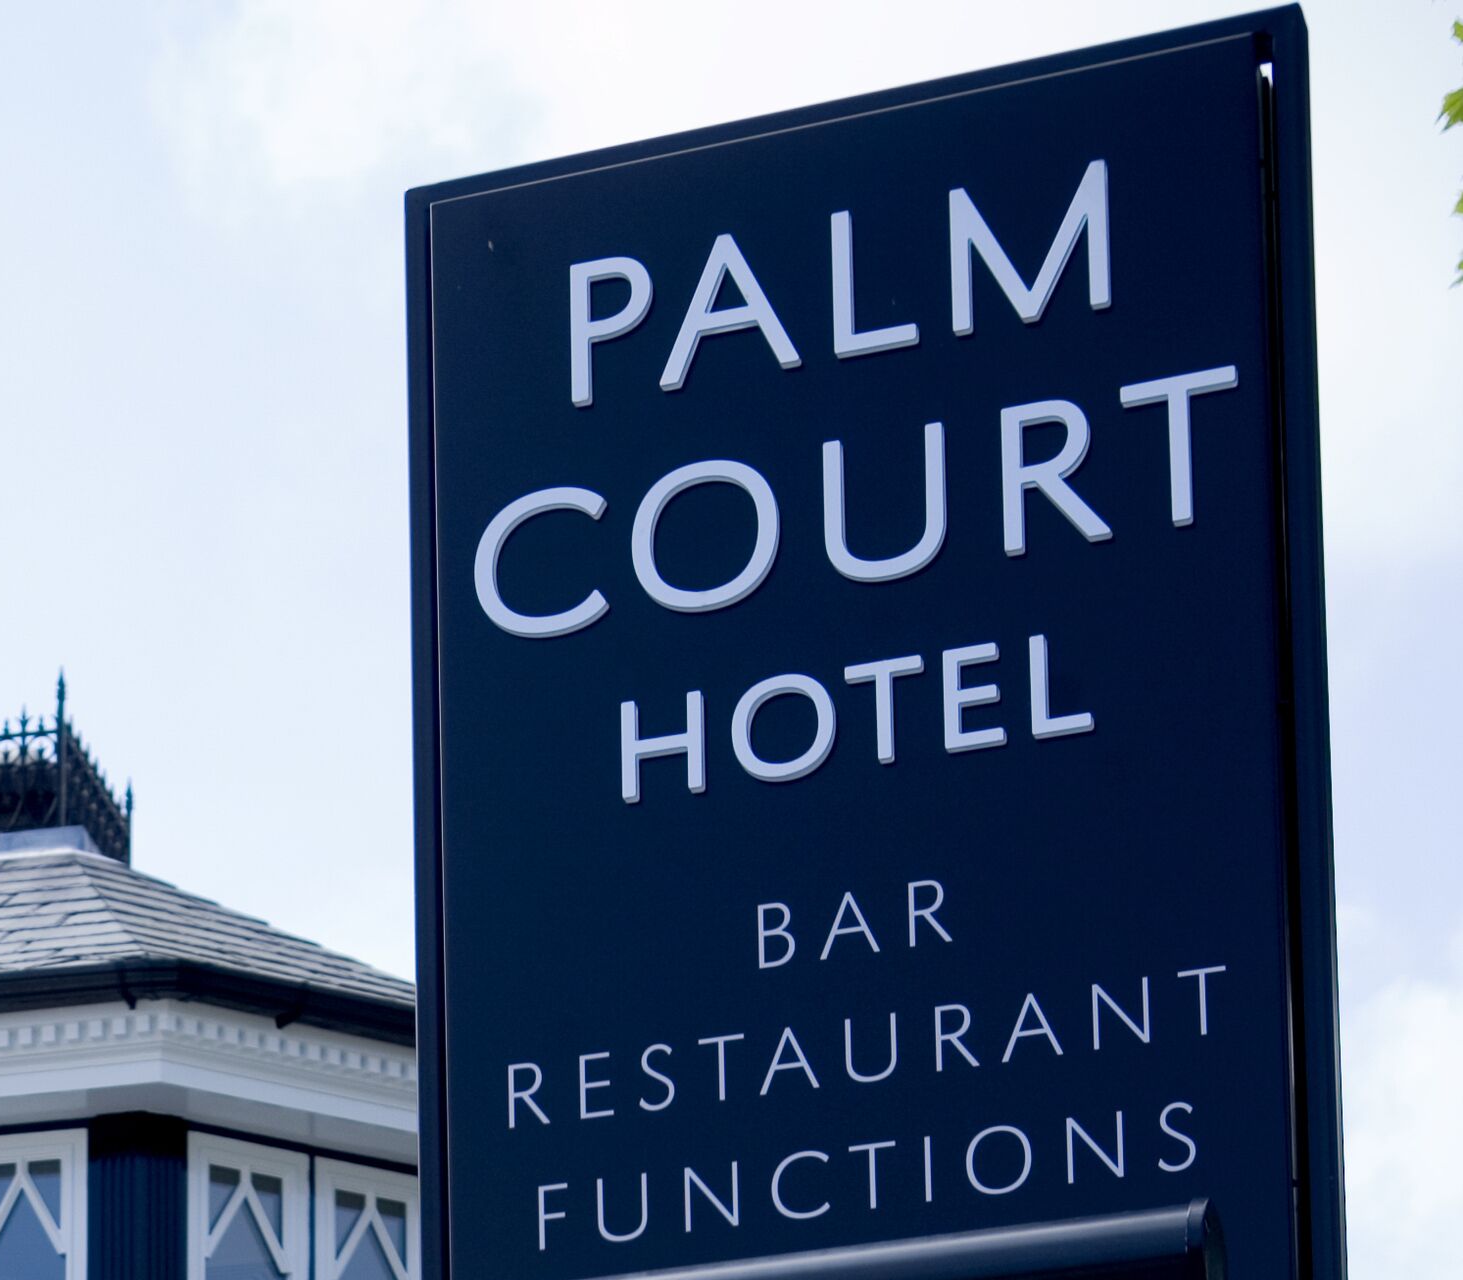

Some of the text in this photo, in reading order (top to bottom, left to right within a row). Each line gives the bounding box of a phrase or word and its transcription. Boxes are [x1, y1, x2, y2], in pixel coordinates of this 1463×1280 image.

[568, 158, 1112, 408] PALM
[473, 363, 1239, 638] COURT
[620, 633, 1095, 805] HOTEL
[757, 879, 953, 969] BAR
[507, 965, 1228, 1129] RESTAURANT
[536, 1101, 1198, 1251] FUNCTIONS
